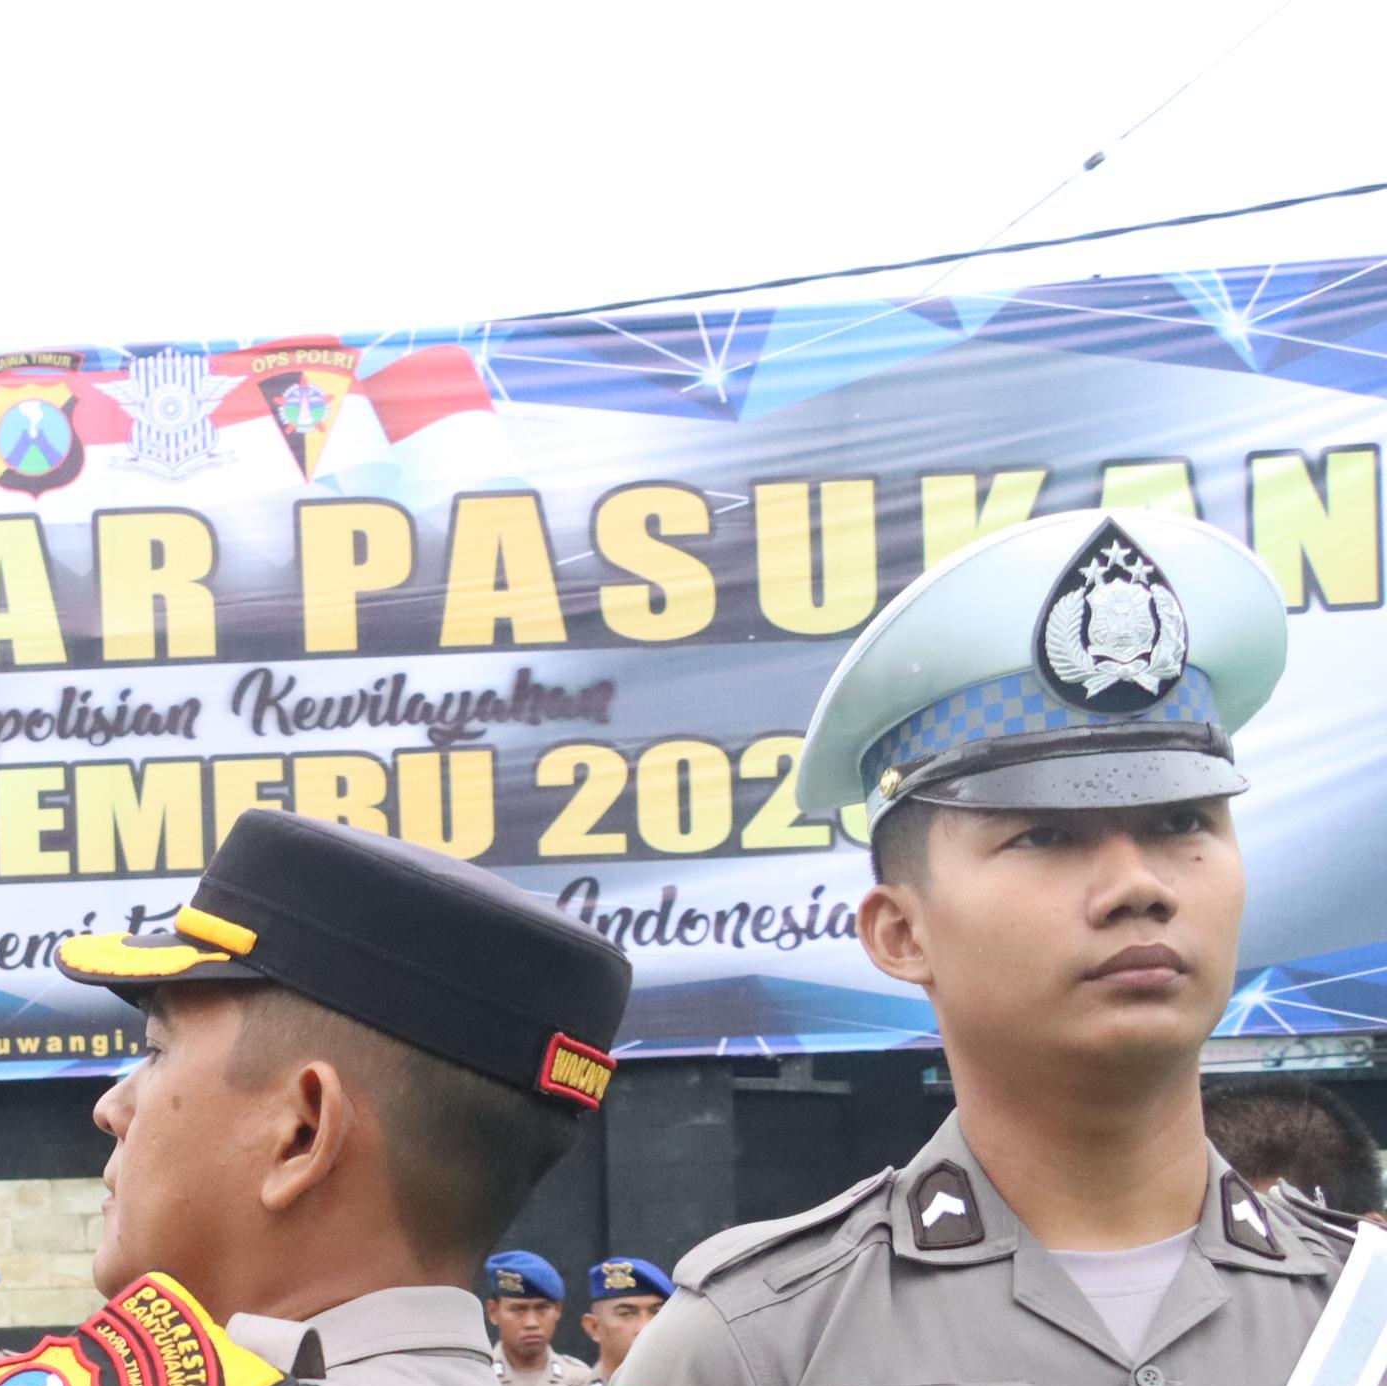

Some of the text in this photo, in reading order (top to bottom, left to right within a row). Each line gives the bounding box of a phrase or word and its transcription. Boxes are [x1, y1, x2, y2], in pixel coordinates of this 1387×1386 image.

[251, 348, 356, 373] OPS POLRI
[534, 731, 871, 859] 202
